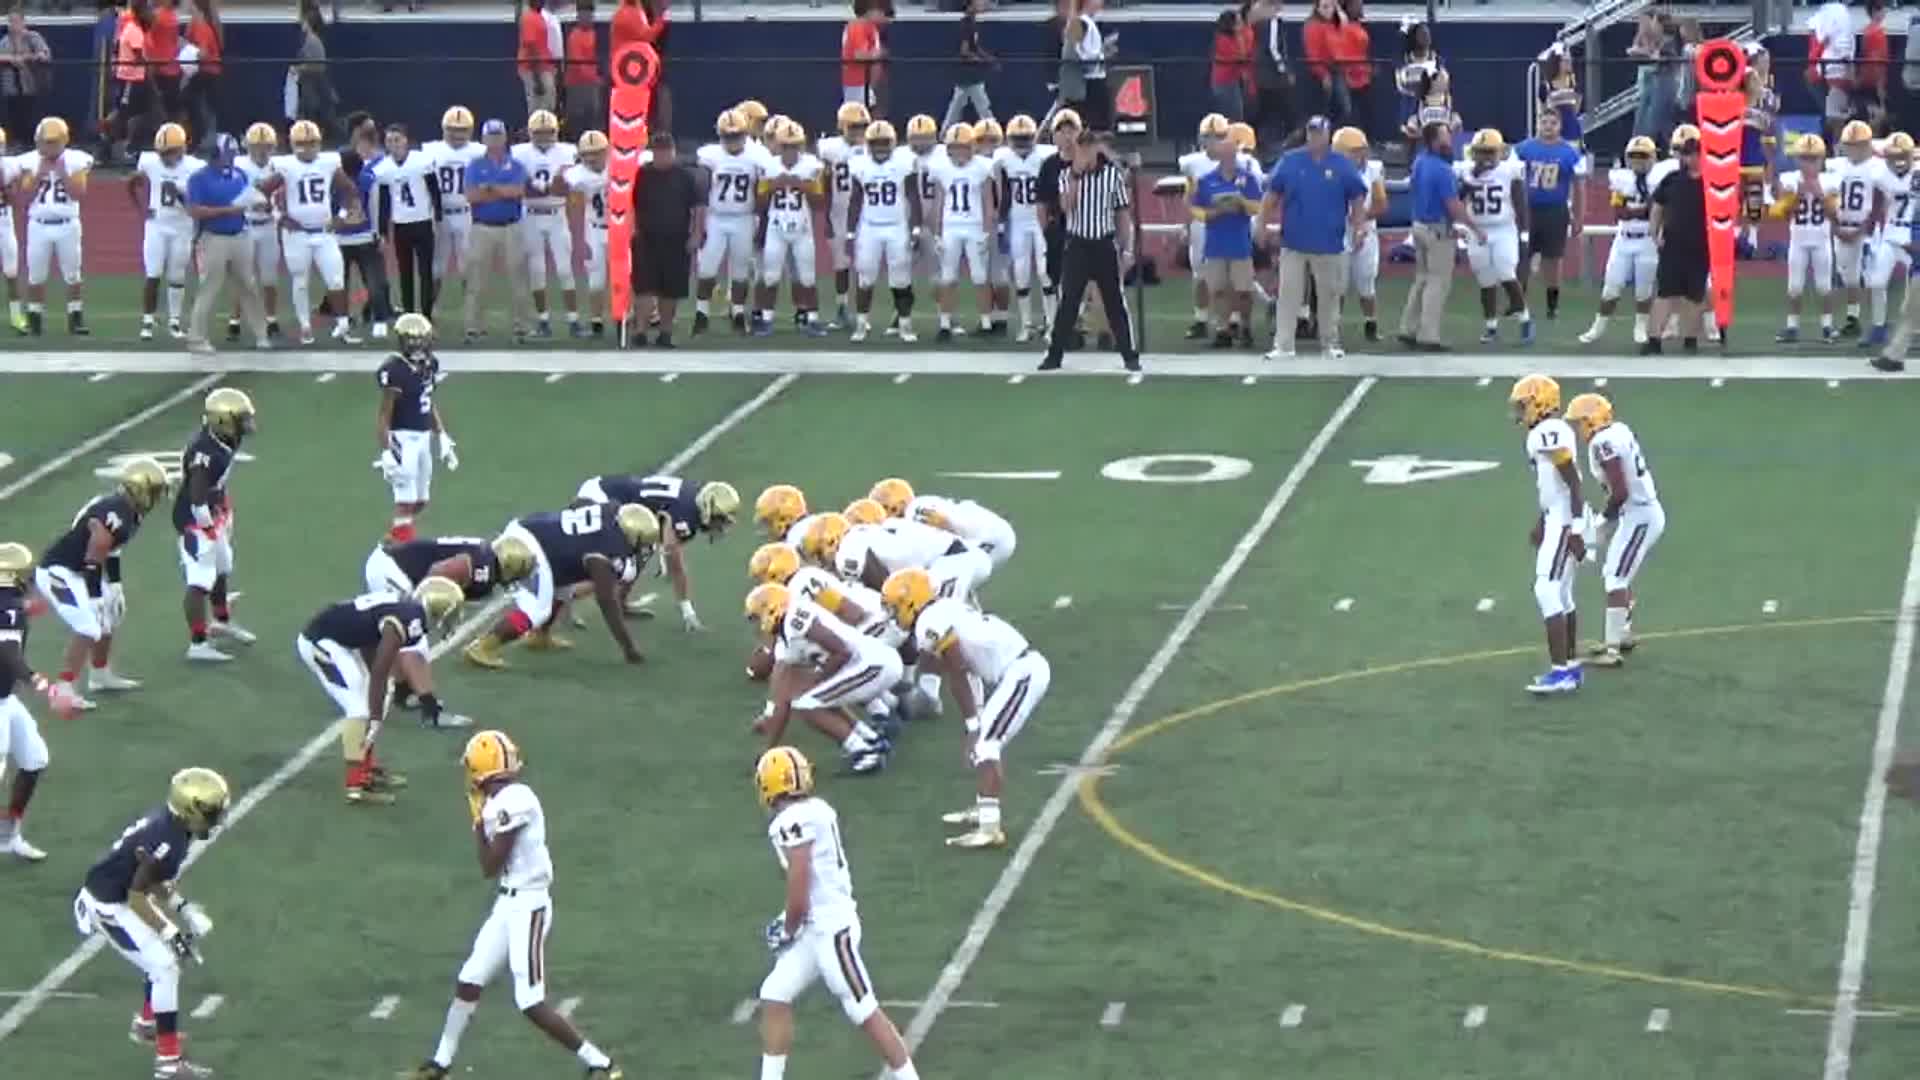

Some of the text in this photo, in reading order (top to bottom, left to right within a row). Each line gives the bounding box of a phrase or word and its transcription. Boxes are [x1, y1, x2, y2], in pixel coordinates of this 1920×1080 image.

[1114, 75, 1148, 117] 4
[439, 167, 465, 194] 81
[717, 174, 749, 202] 79
[400, 183, 415, 207] 4
[950, 183, 970, 212] 11
[1840, 180, 1865, 210] 16
[1541, 431, 1560, 447] 17
[790, 607, 811, 631] 86
[780, 822, 803, 841] 14
